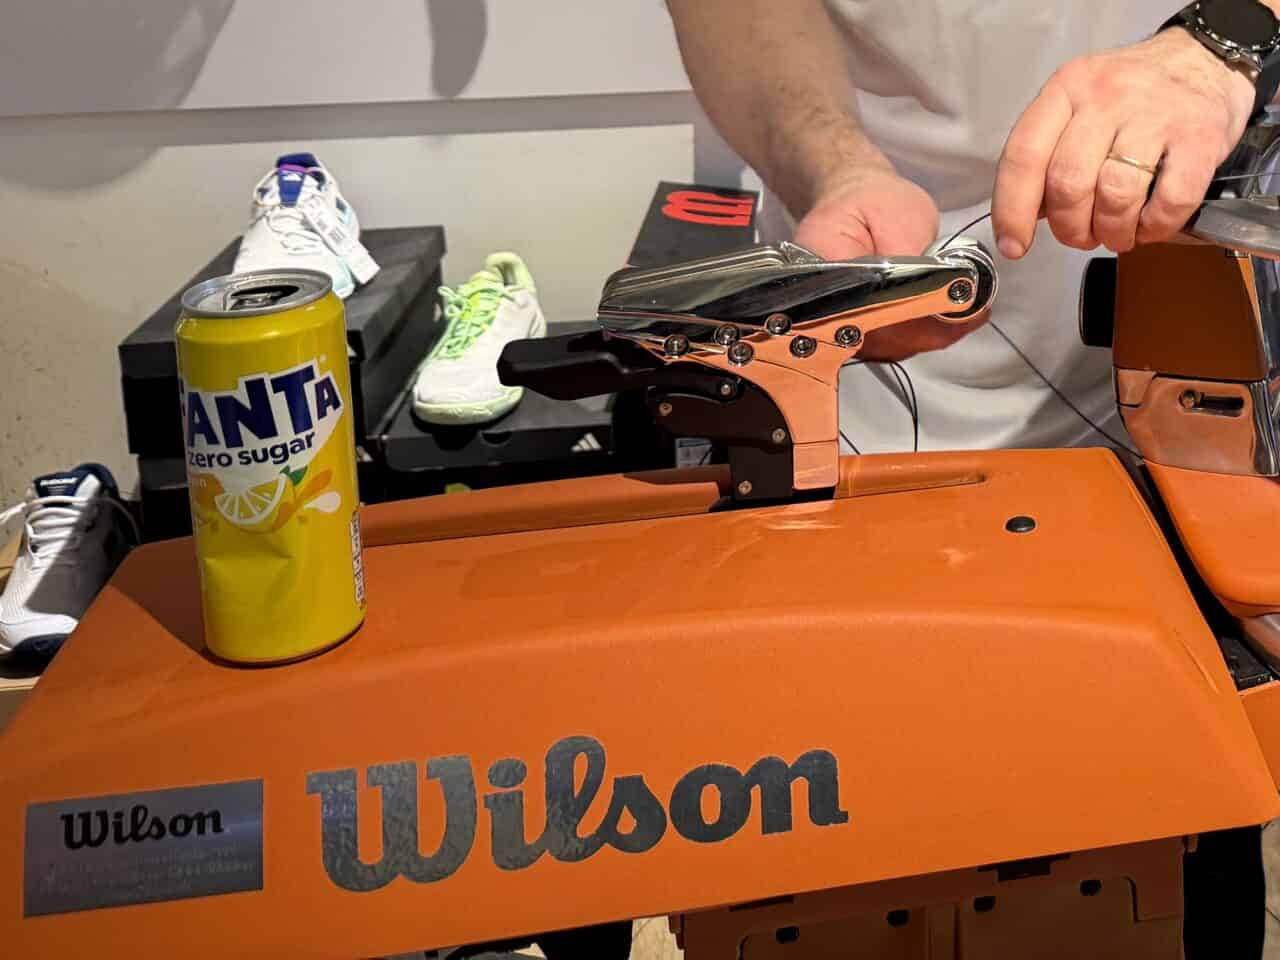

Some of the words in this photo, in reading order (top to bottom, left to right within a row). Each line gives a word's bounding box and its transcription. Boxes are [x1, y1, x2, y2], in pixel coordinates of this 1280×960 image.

[179, 364, 341, 449] ANTA
[189, 449, 233, 469] zero
[237, 432, 316, 465] sugar
[60, 804, 224, 850] Wilson
[306, 735, 849, 893] Wilson
